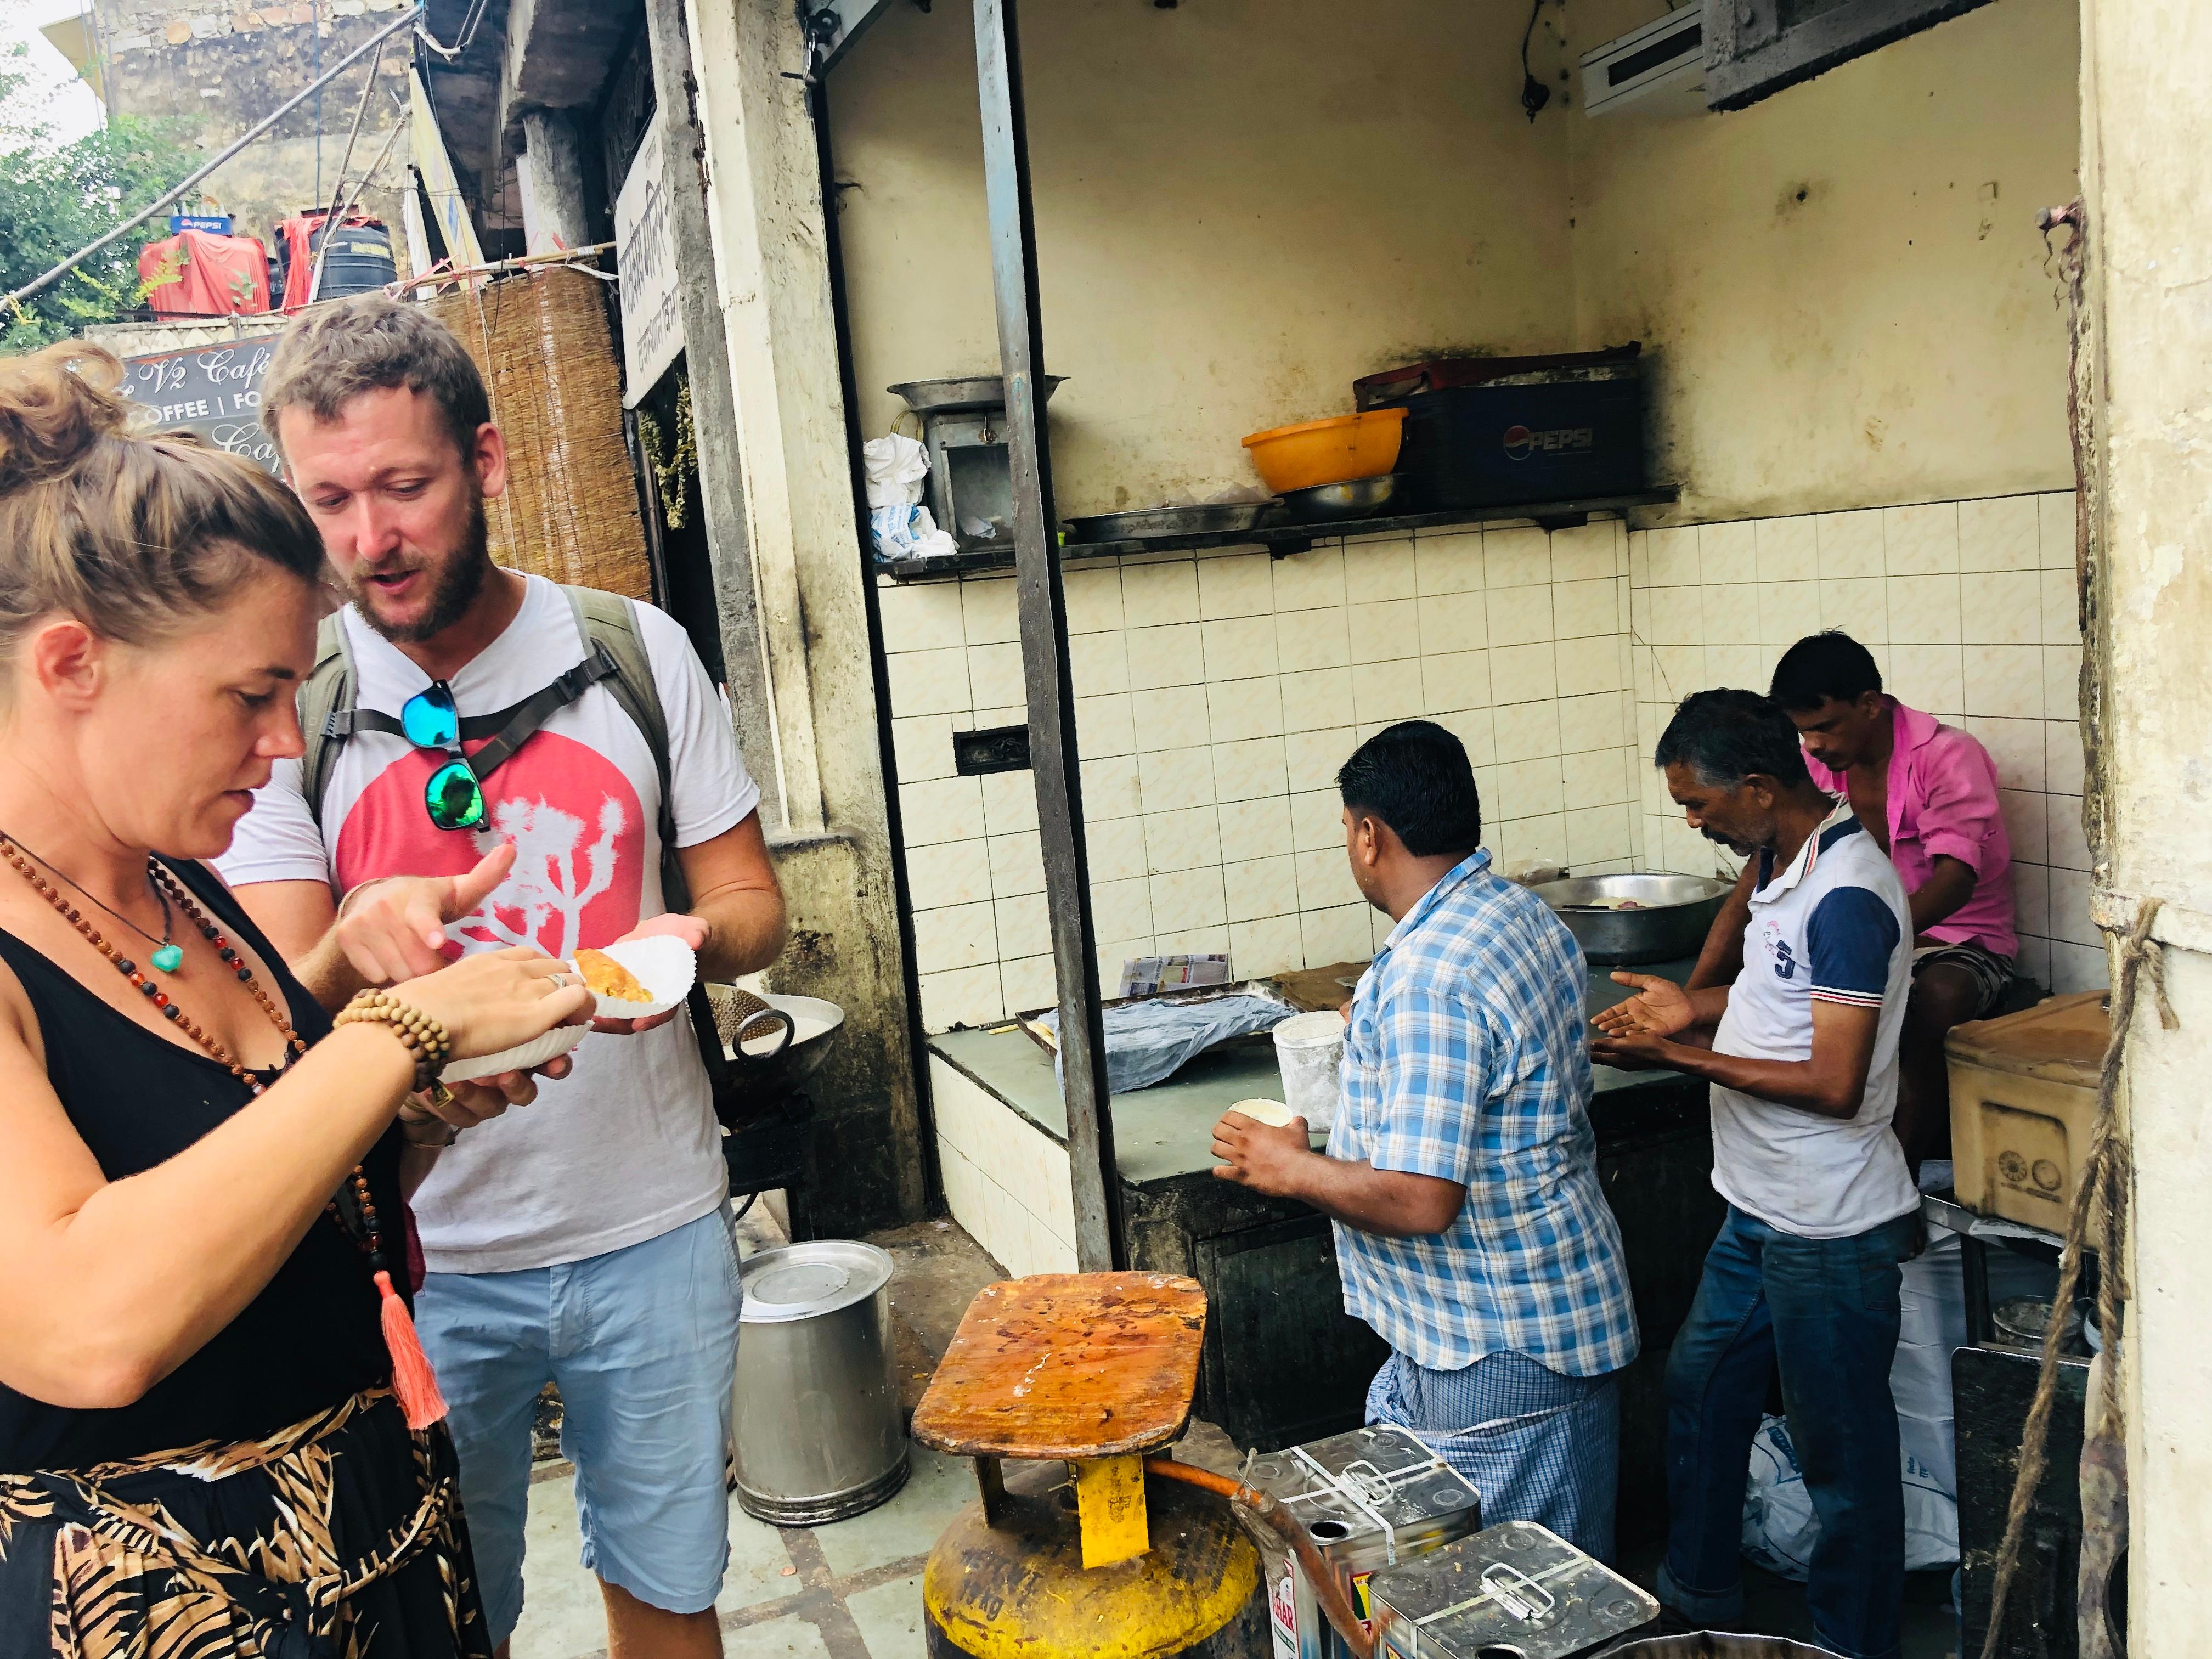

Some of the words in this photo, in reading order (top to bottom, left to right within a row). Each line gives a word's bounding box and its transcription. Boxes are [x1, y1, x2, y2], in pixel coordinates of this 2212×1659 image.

[194, 221, 222, 229] PEPSI
[662, 281, 681, 333] विभा
[139, 357, 187, 394] V2
[198, 347, 270, 389] Café
[233, 391, 262, 410] FO
[1528, 428, 1592, 451] PEPSI
